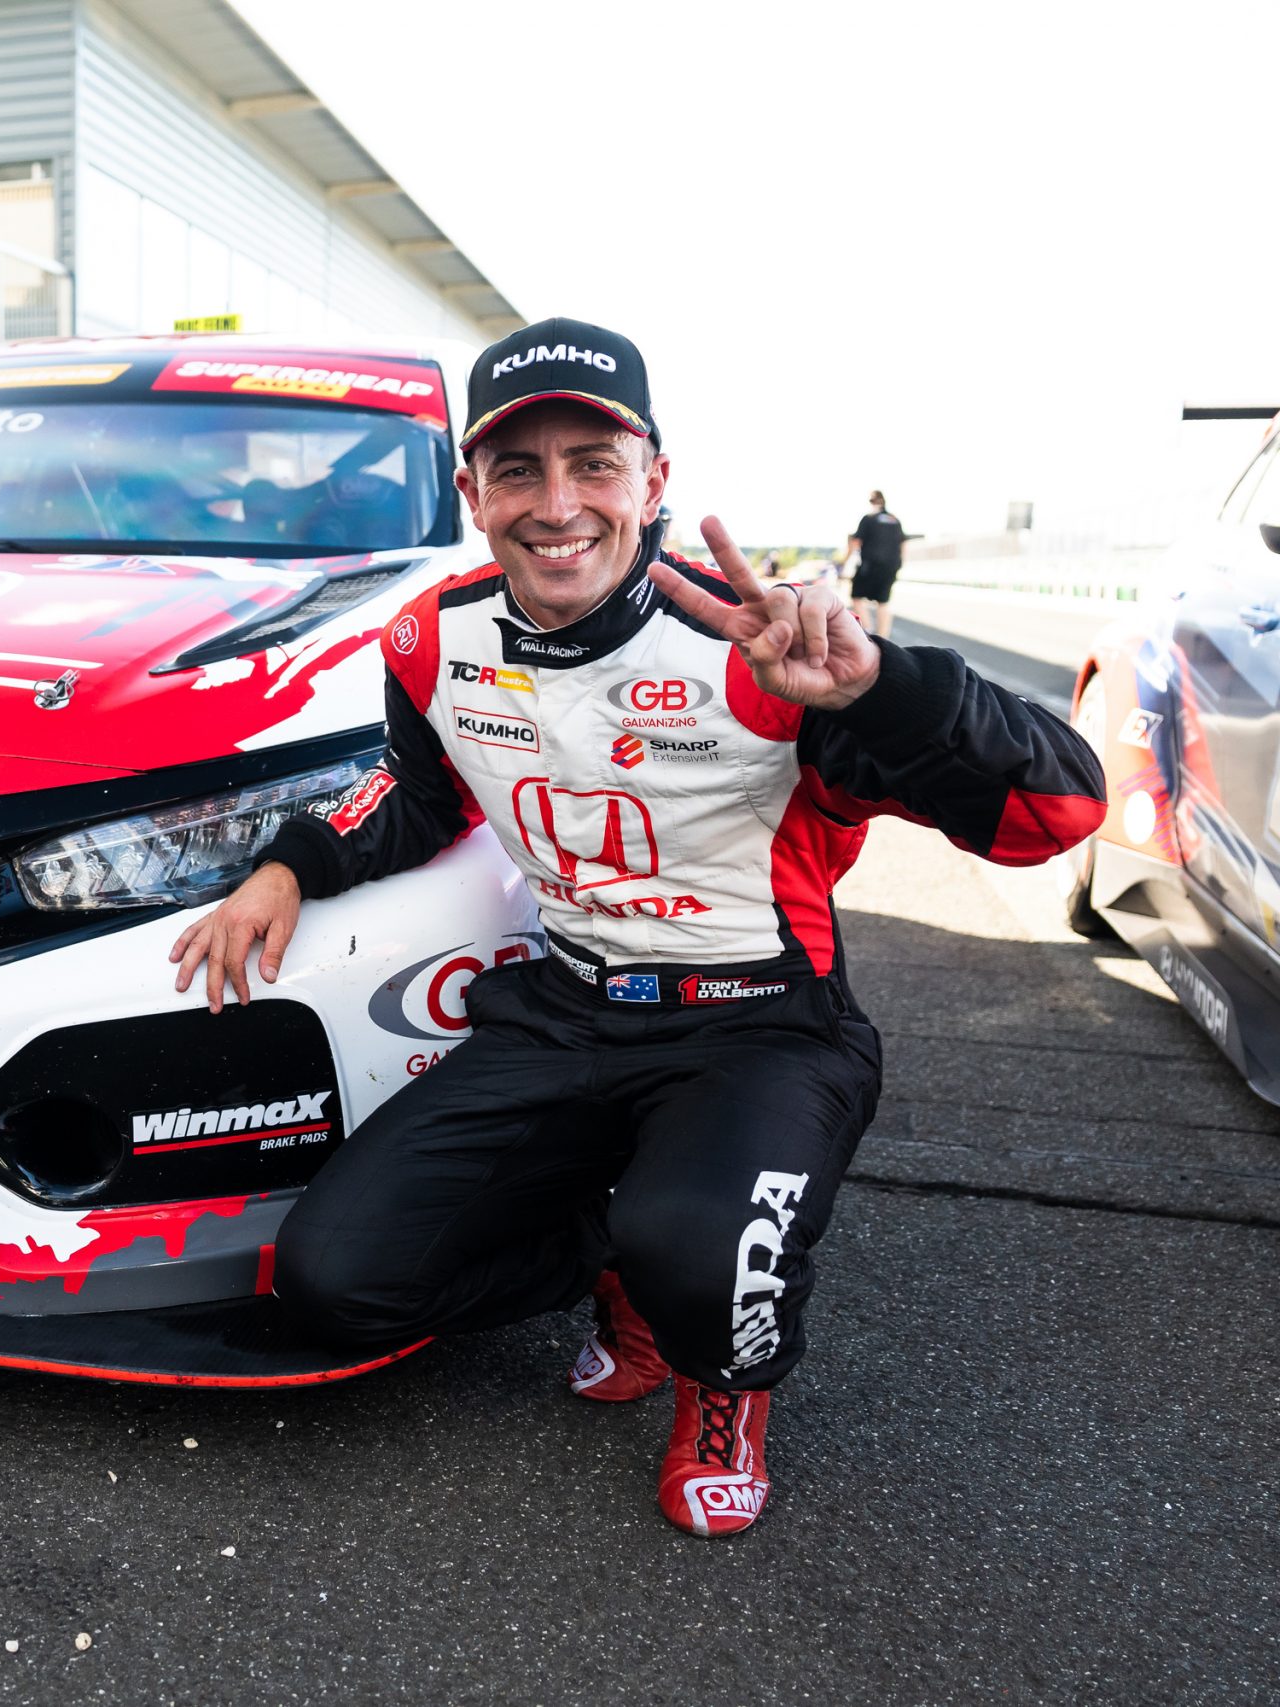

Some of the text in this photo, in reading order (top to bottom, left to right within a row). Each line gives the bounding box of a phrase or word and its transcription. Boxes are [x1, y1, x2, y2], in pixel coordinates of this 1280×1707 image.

[492, 344, 617, 380] KUMHO
[175, 361, 434, 397] SUPERCHEAP
[249, 379, 333, 392] AUTO
[397, 626, 412, 646] 21
[520, 641, 583, 658] WALL RACING
[448, 660, 532, 688] TCR Austra
[630, 680, 688, 711] GB
[457, 716, 535, 743] KUMHO
[650, 740, 718, 751] SHARP
[653, 752, 720, 763] Extensive IT
[539, 880, 713, 918] HONDA
[549, 940, 599, 974] OTORSPORT
[427, 943, 531, 1031] G
[697, 985, 786, 999] D'ALBERTO
[698, 980, 744, 990] TONY
[260, 1131, 329, 1150] BRAKE PADS
[575, 1346, 604, 1377] MP
